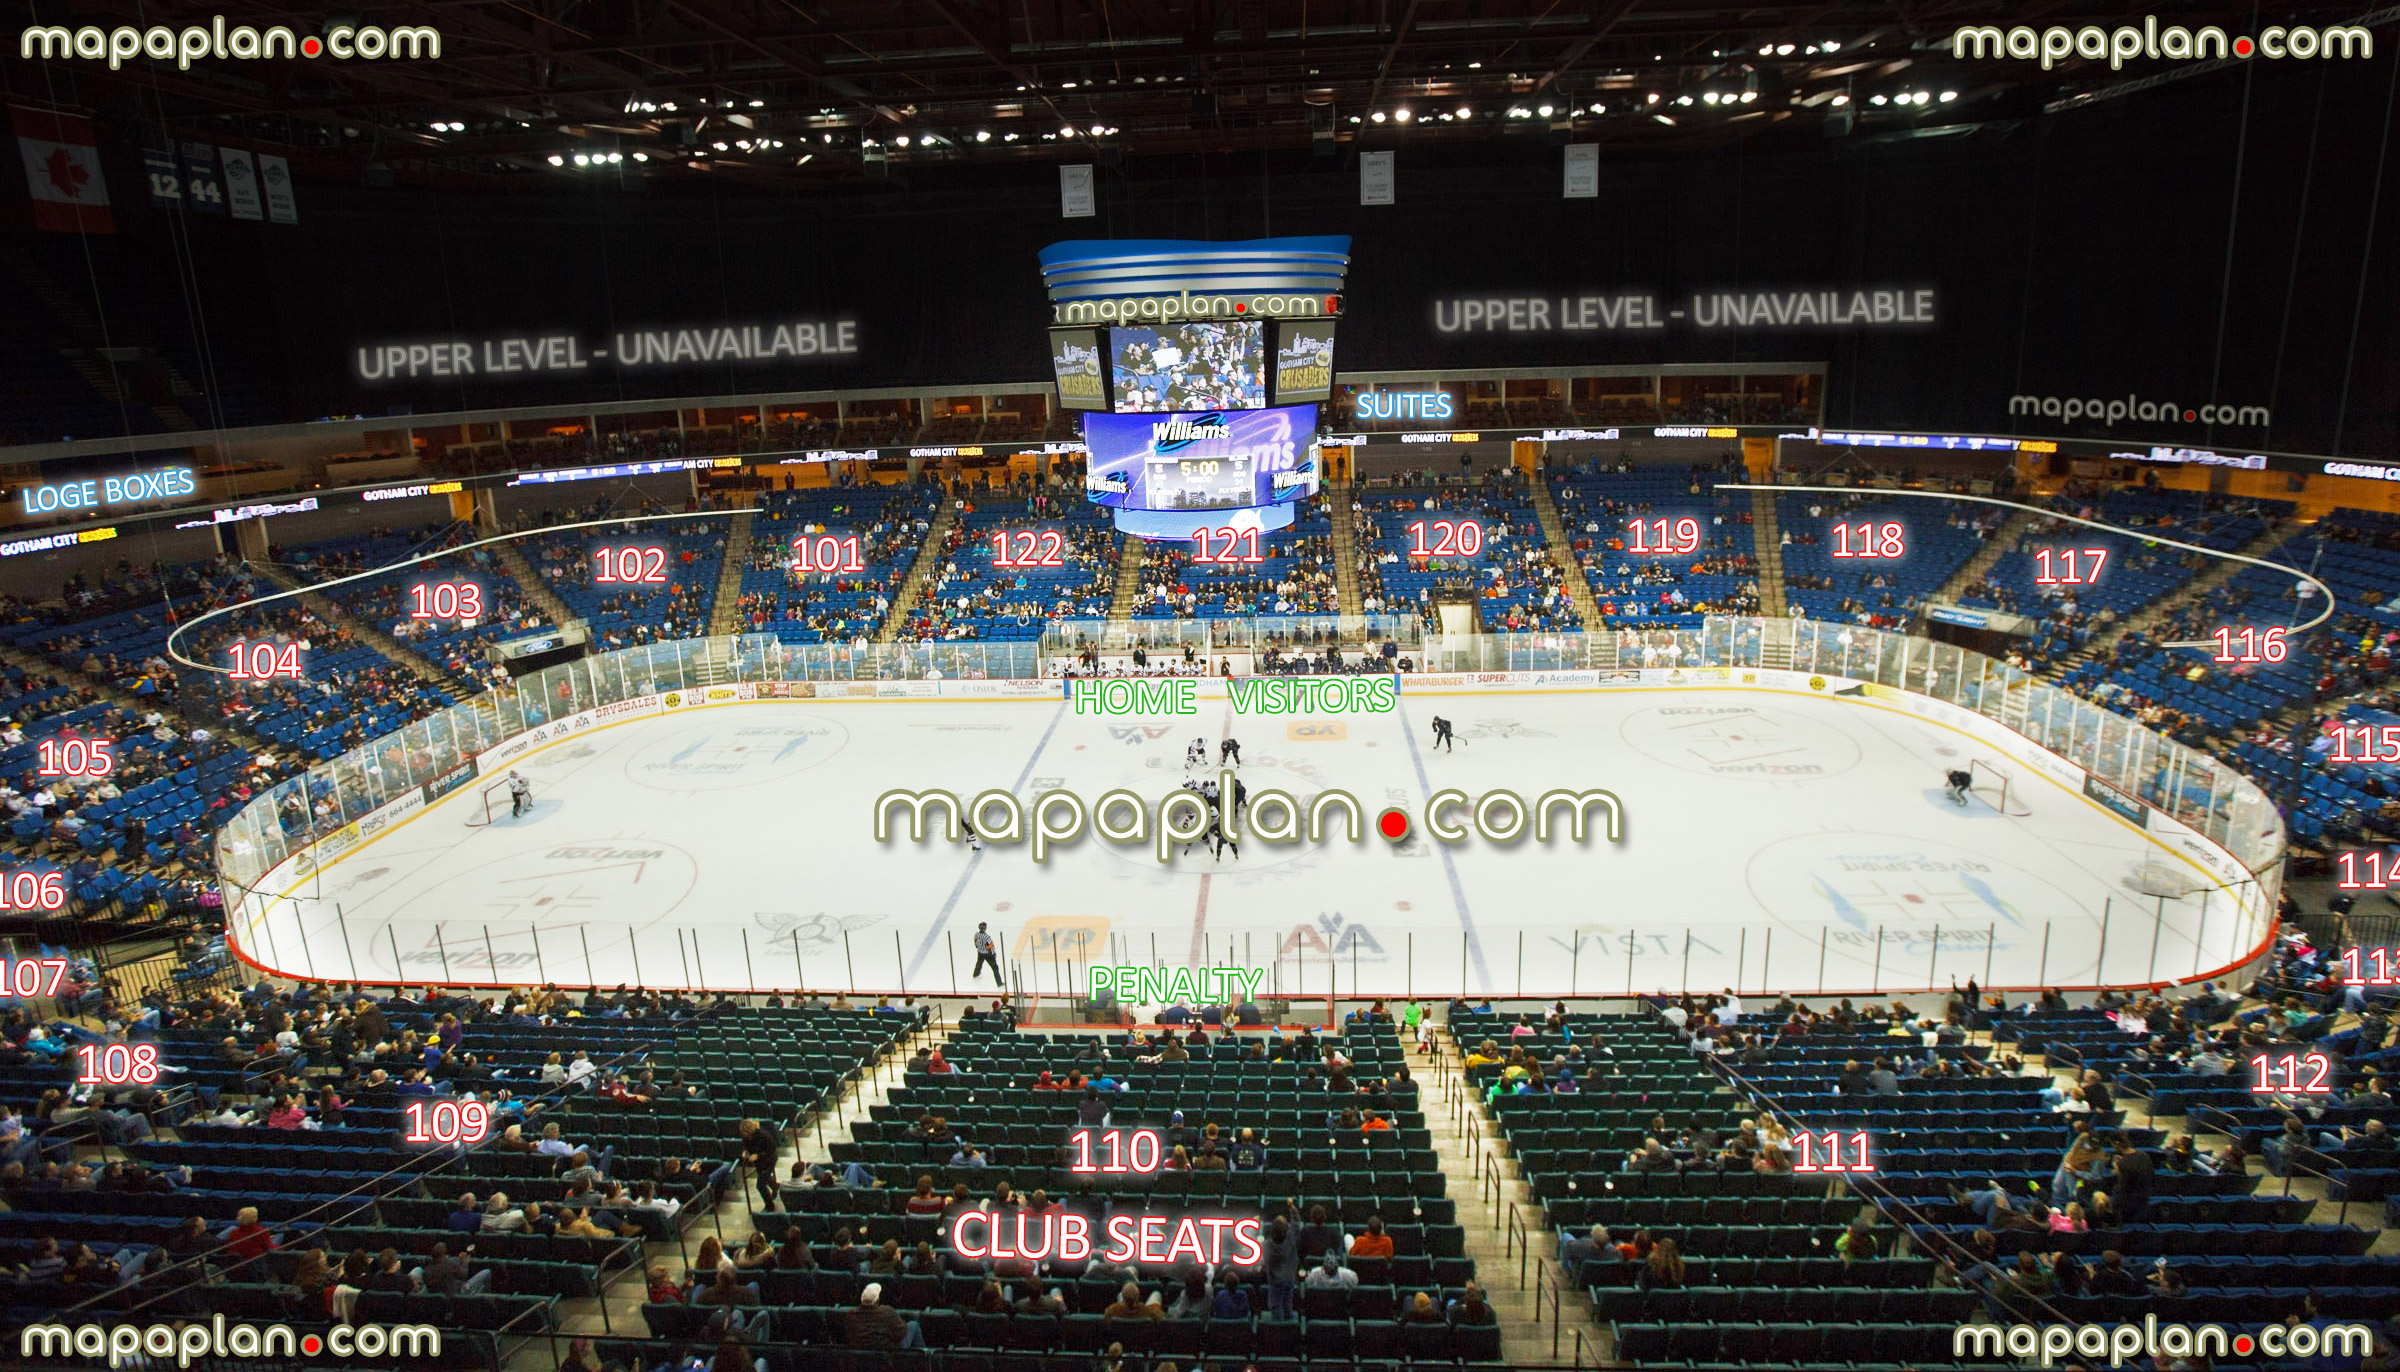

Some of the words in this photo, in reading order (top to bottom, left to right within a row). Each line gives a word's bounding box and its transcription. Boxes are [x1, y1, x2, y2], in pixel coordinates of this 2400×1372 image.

[150, 173, 182, 200] 12
[191, 178, 222, 204] 44
[1279, 365, 1330, 389] CRUSADERS
[1153, 421, 1231, 441] Williams
[1401, 433, 1435, 443] GOTHAM
[1435, 433, 1452, 443] CITY
[1654, 427, 1690, 438] GOTHAM
[1690, 427, 1708, 438] CITY
[910, 448, 941, 457] GOTHAM
[941, 447, 957, 457] CITY
[696, 458, 714, 469] CITY
[1180, 460, 1220, 477] 5:00
[1086, 474, 1127, 494] Williams
[1273, 468, 1317, 488] Williams
[363, 487, 407, 501] GOTHAM
[407, 485, 429, 497] CITY
[1402, 677, 1464, 687] WHATABURGER
[1477, 673, 1531, 683] SUPERCUTS
[1549, 674, 1596, 684] Academy
[595, 696, 657, 719] DRYSDALES
[501, 741, 528, 758] verizon
[430, 773, 452, 797] RIVER
[451, 763, 471, 781] SPIRIT
[389, 795, 422, 818] 664-4444
[1034, 927, 1096, 951] yp
[401, 947, 538, 970] verizon
